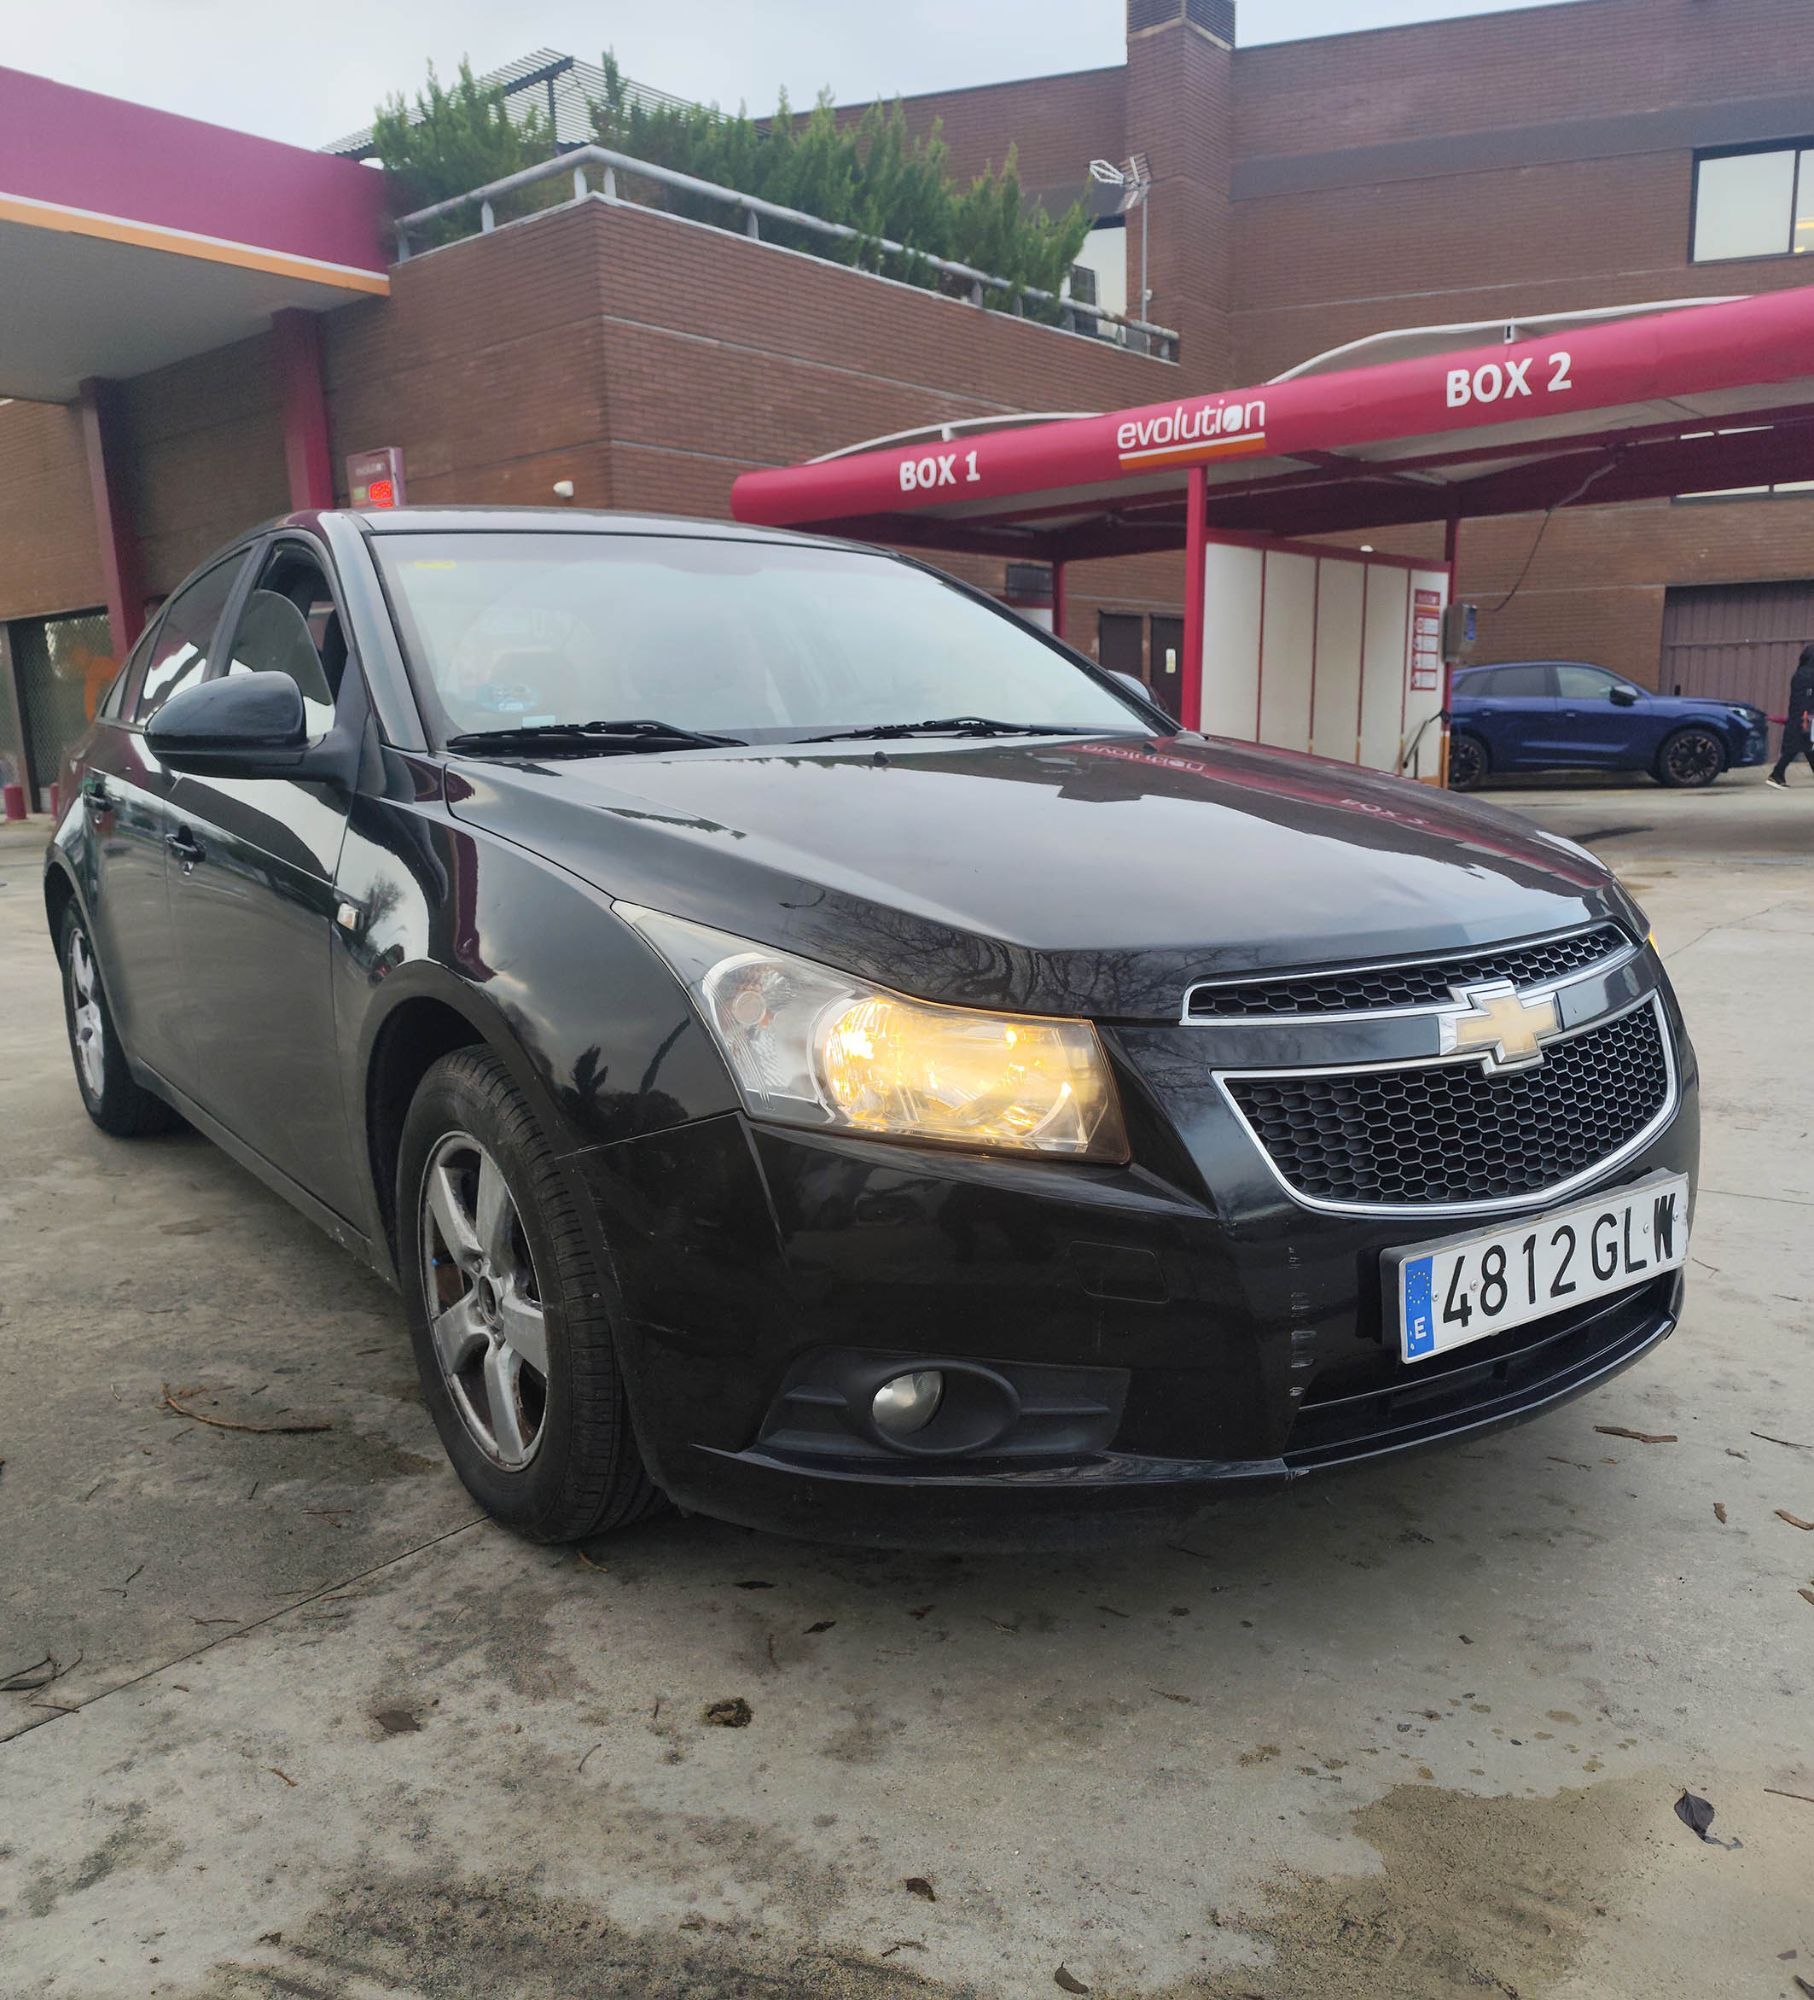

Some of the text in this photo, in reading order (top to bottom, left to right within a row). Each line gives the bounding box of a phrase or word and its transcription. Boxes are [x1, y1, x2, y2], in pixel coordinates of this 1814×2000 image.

[1446, 352, 1572, 408] BOX 2
[1117, 399, 1265, 449] evolution
[900, 451, 981, 491] BOX 1
[1443, 1193, 1676, 1328] 4812 GLW
[1414, 1316, 1427, 1340] E
